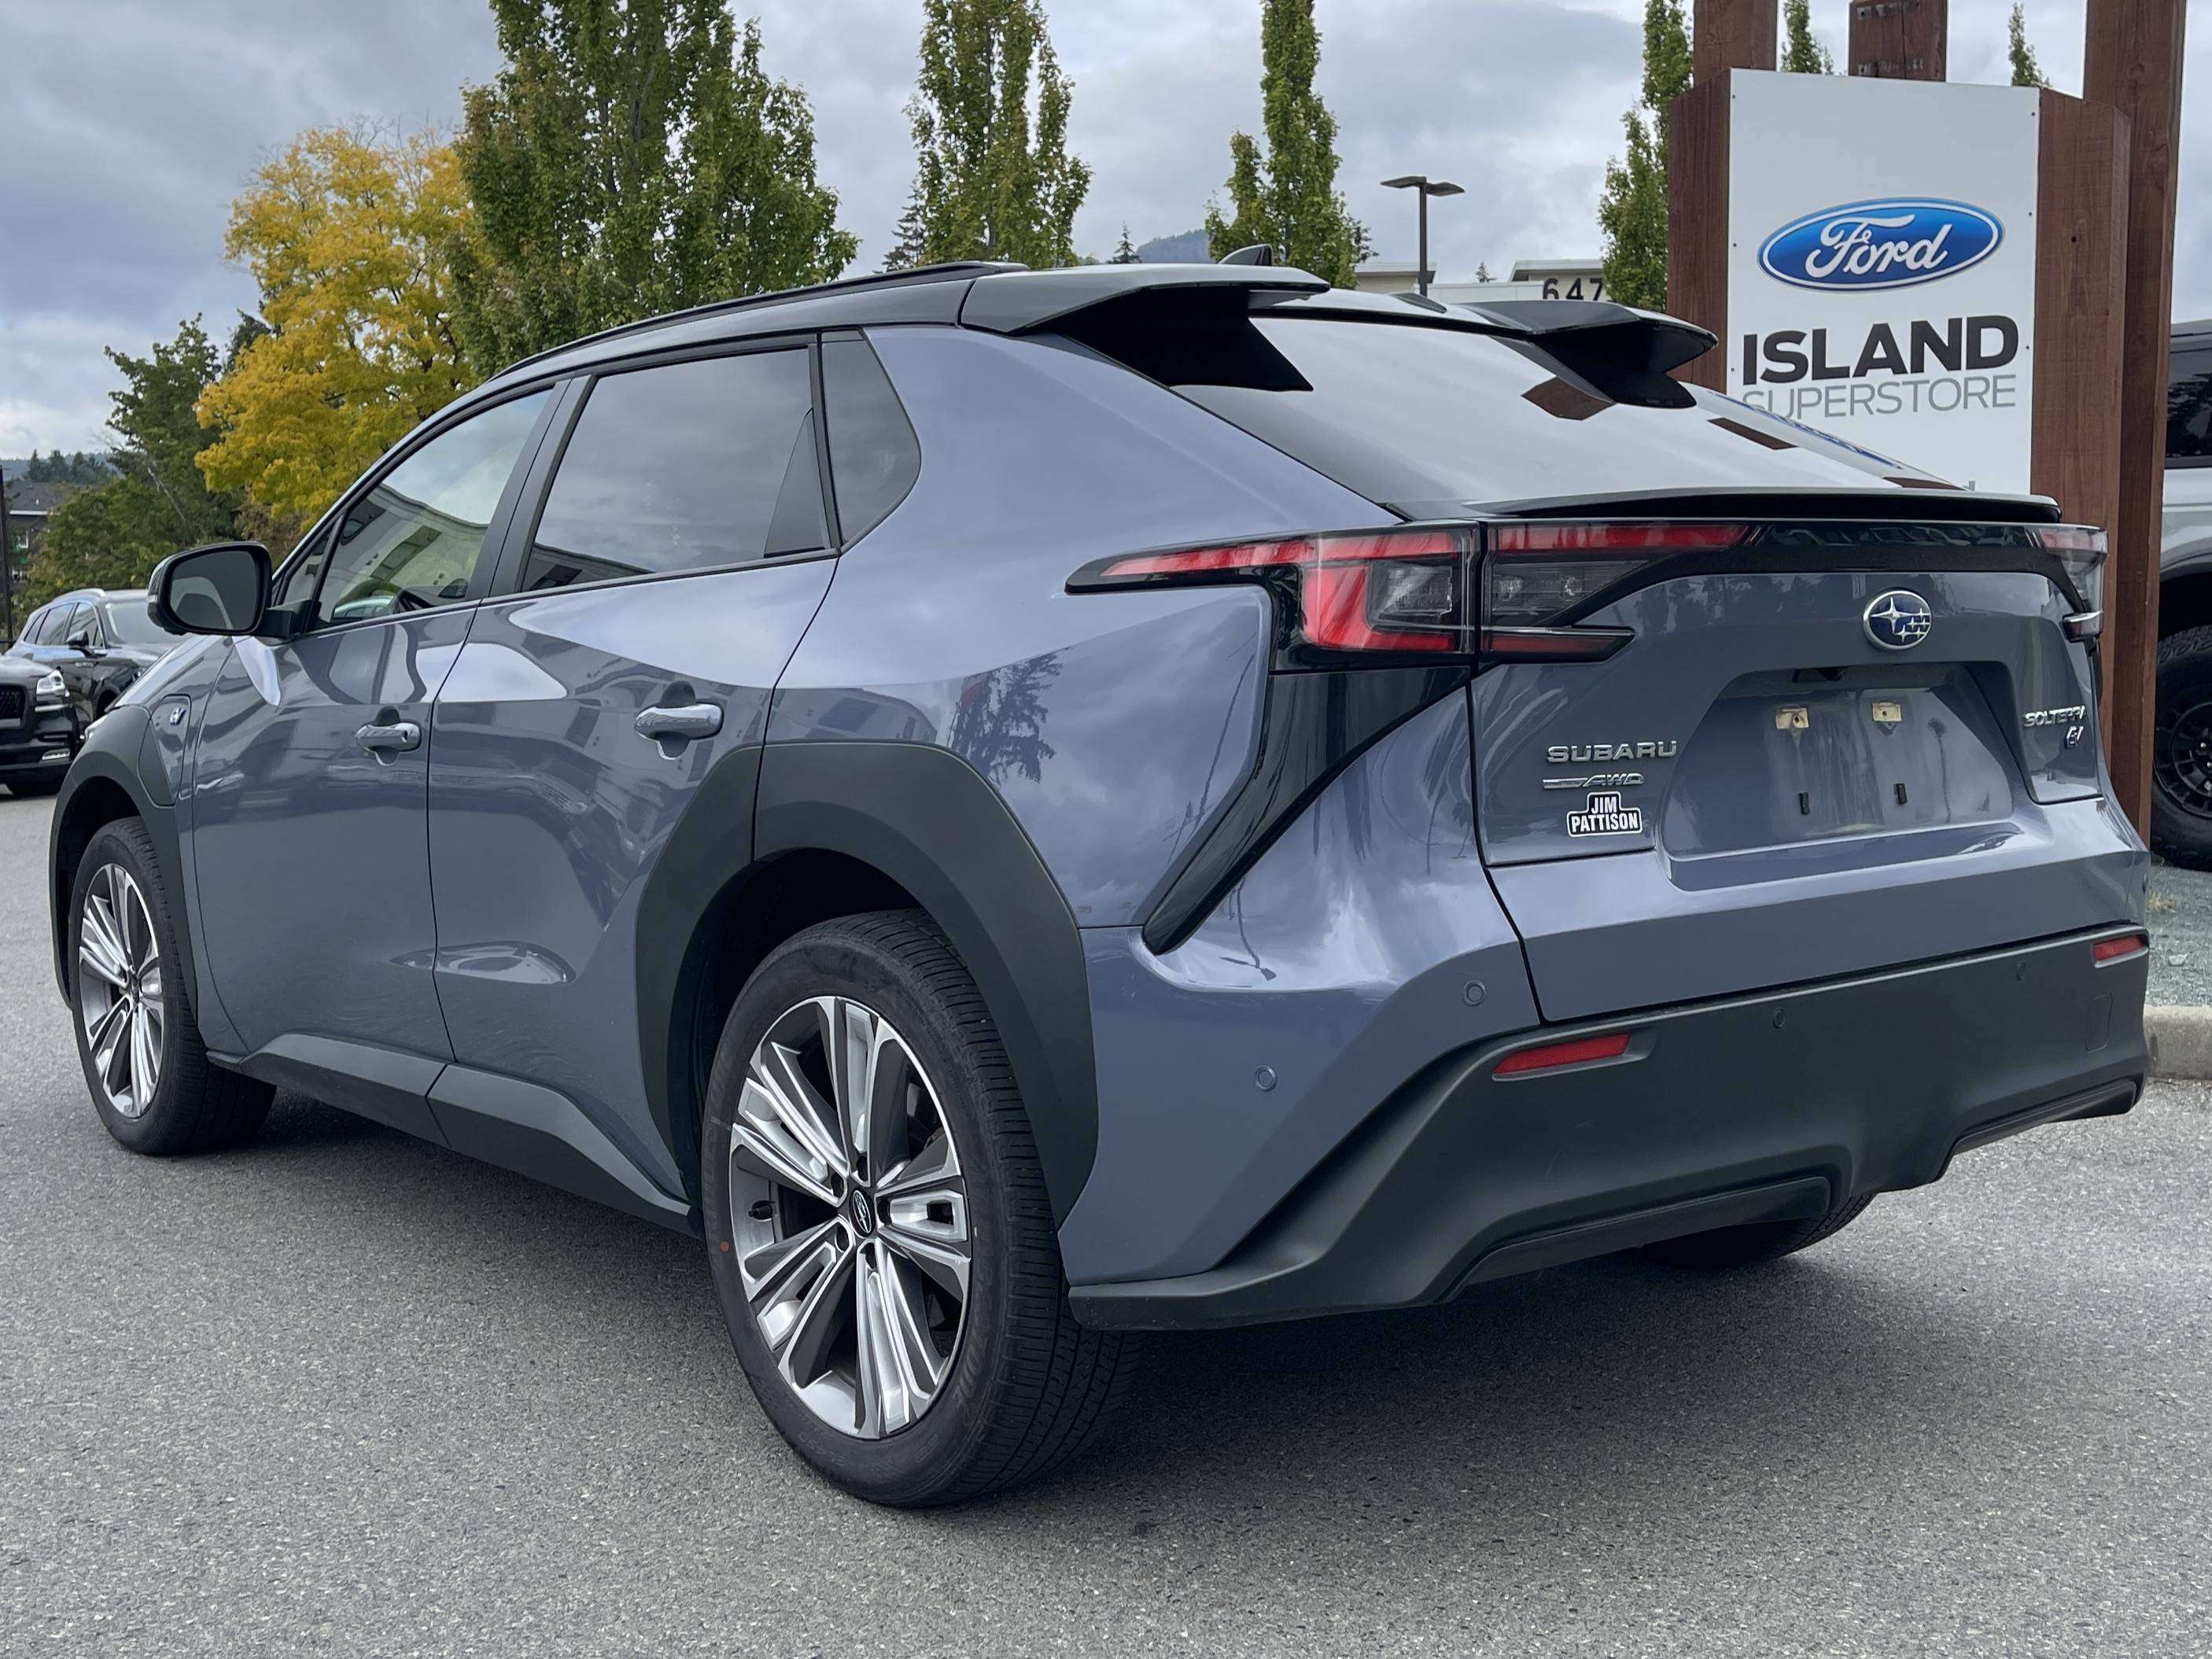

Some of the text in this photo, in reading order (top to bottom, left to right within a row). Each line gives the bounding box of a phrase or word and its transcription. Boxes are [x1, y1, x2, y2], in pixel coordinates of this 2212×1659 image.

[1805, 214, 1952, 278] Ford
[1543, 277, 1604, 301] 647
[1742, 315, 2019, 385] ISLAND
[1742, 374, 2016, 420] SUPERSTORE
[1547, 740, 1677, 763] SUBARU
[1582, 772, 1645, 787] AWD
[1591, 796, 1617, 815] JIM
[1571, 812, 1639, 832] PATTISON
